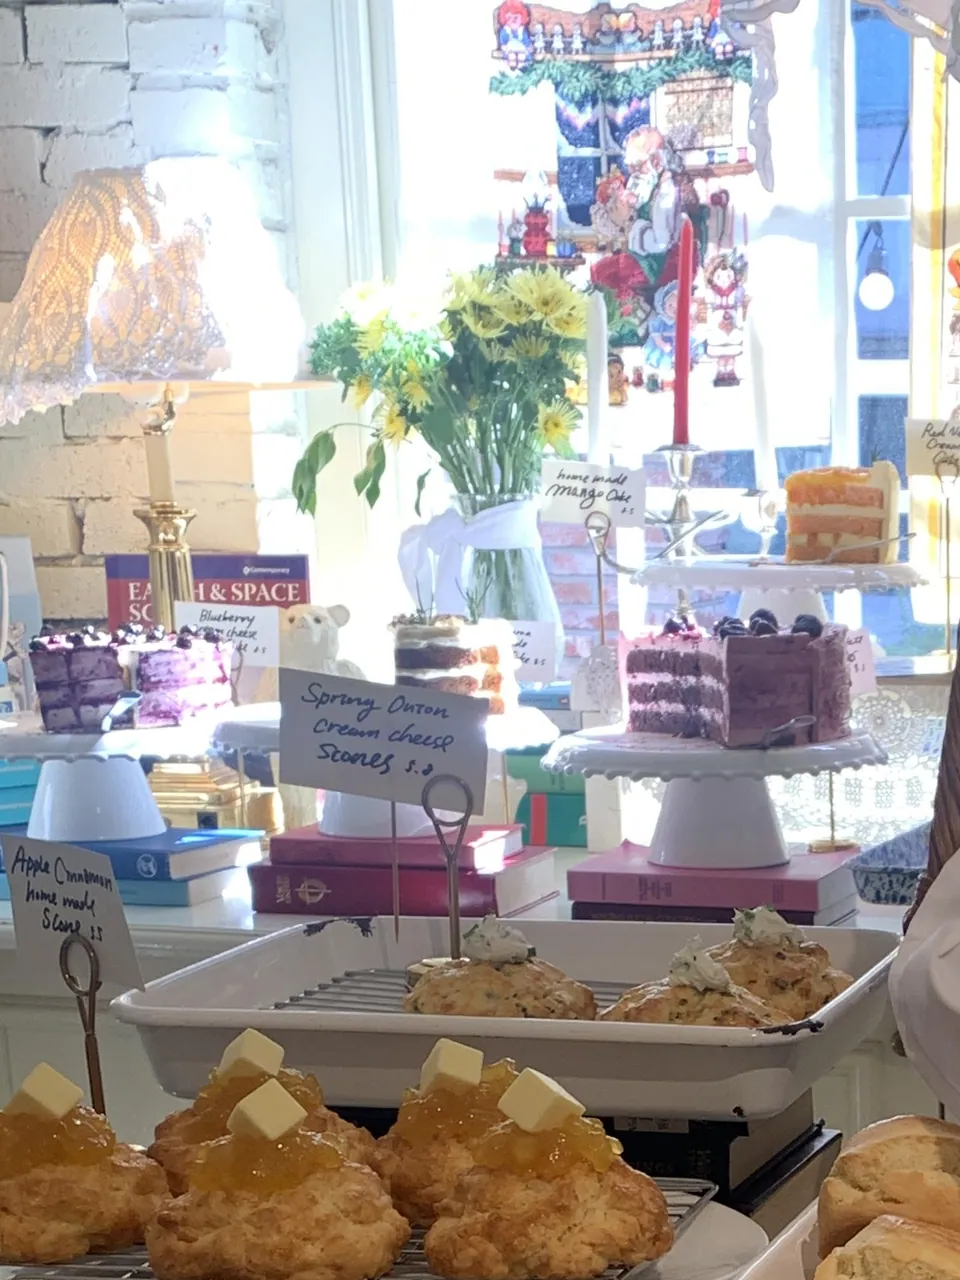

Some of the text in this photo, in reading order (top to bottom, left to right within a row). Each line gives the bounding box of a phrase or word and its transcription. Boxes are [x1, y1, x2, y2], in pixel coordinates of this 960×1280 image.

[210, 583, 226, 601] &
[231, 582, 300, 602] SPACE
[387, 695, 450, 720] Onion
[388, 723, 455, 753] cheese
[316, 743, 395, 776] Scones
[11, 845, 51, 878] Apple
[25, 880, 97, 918] home made
